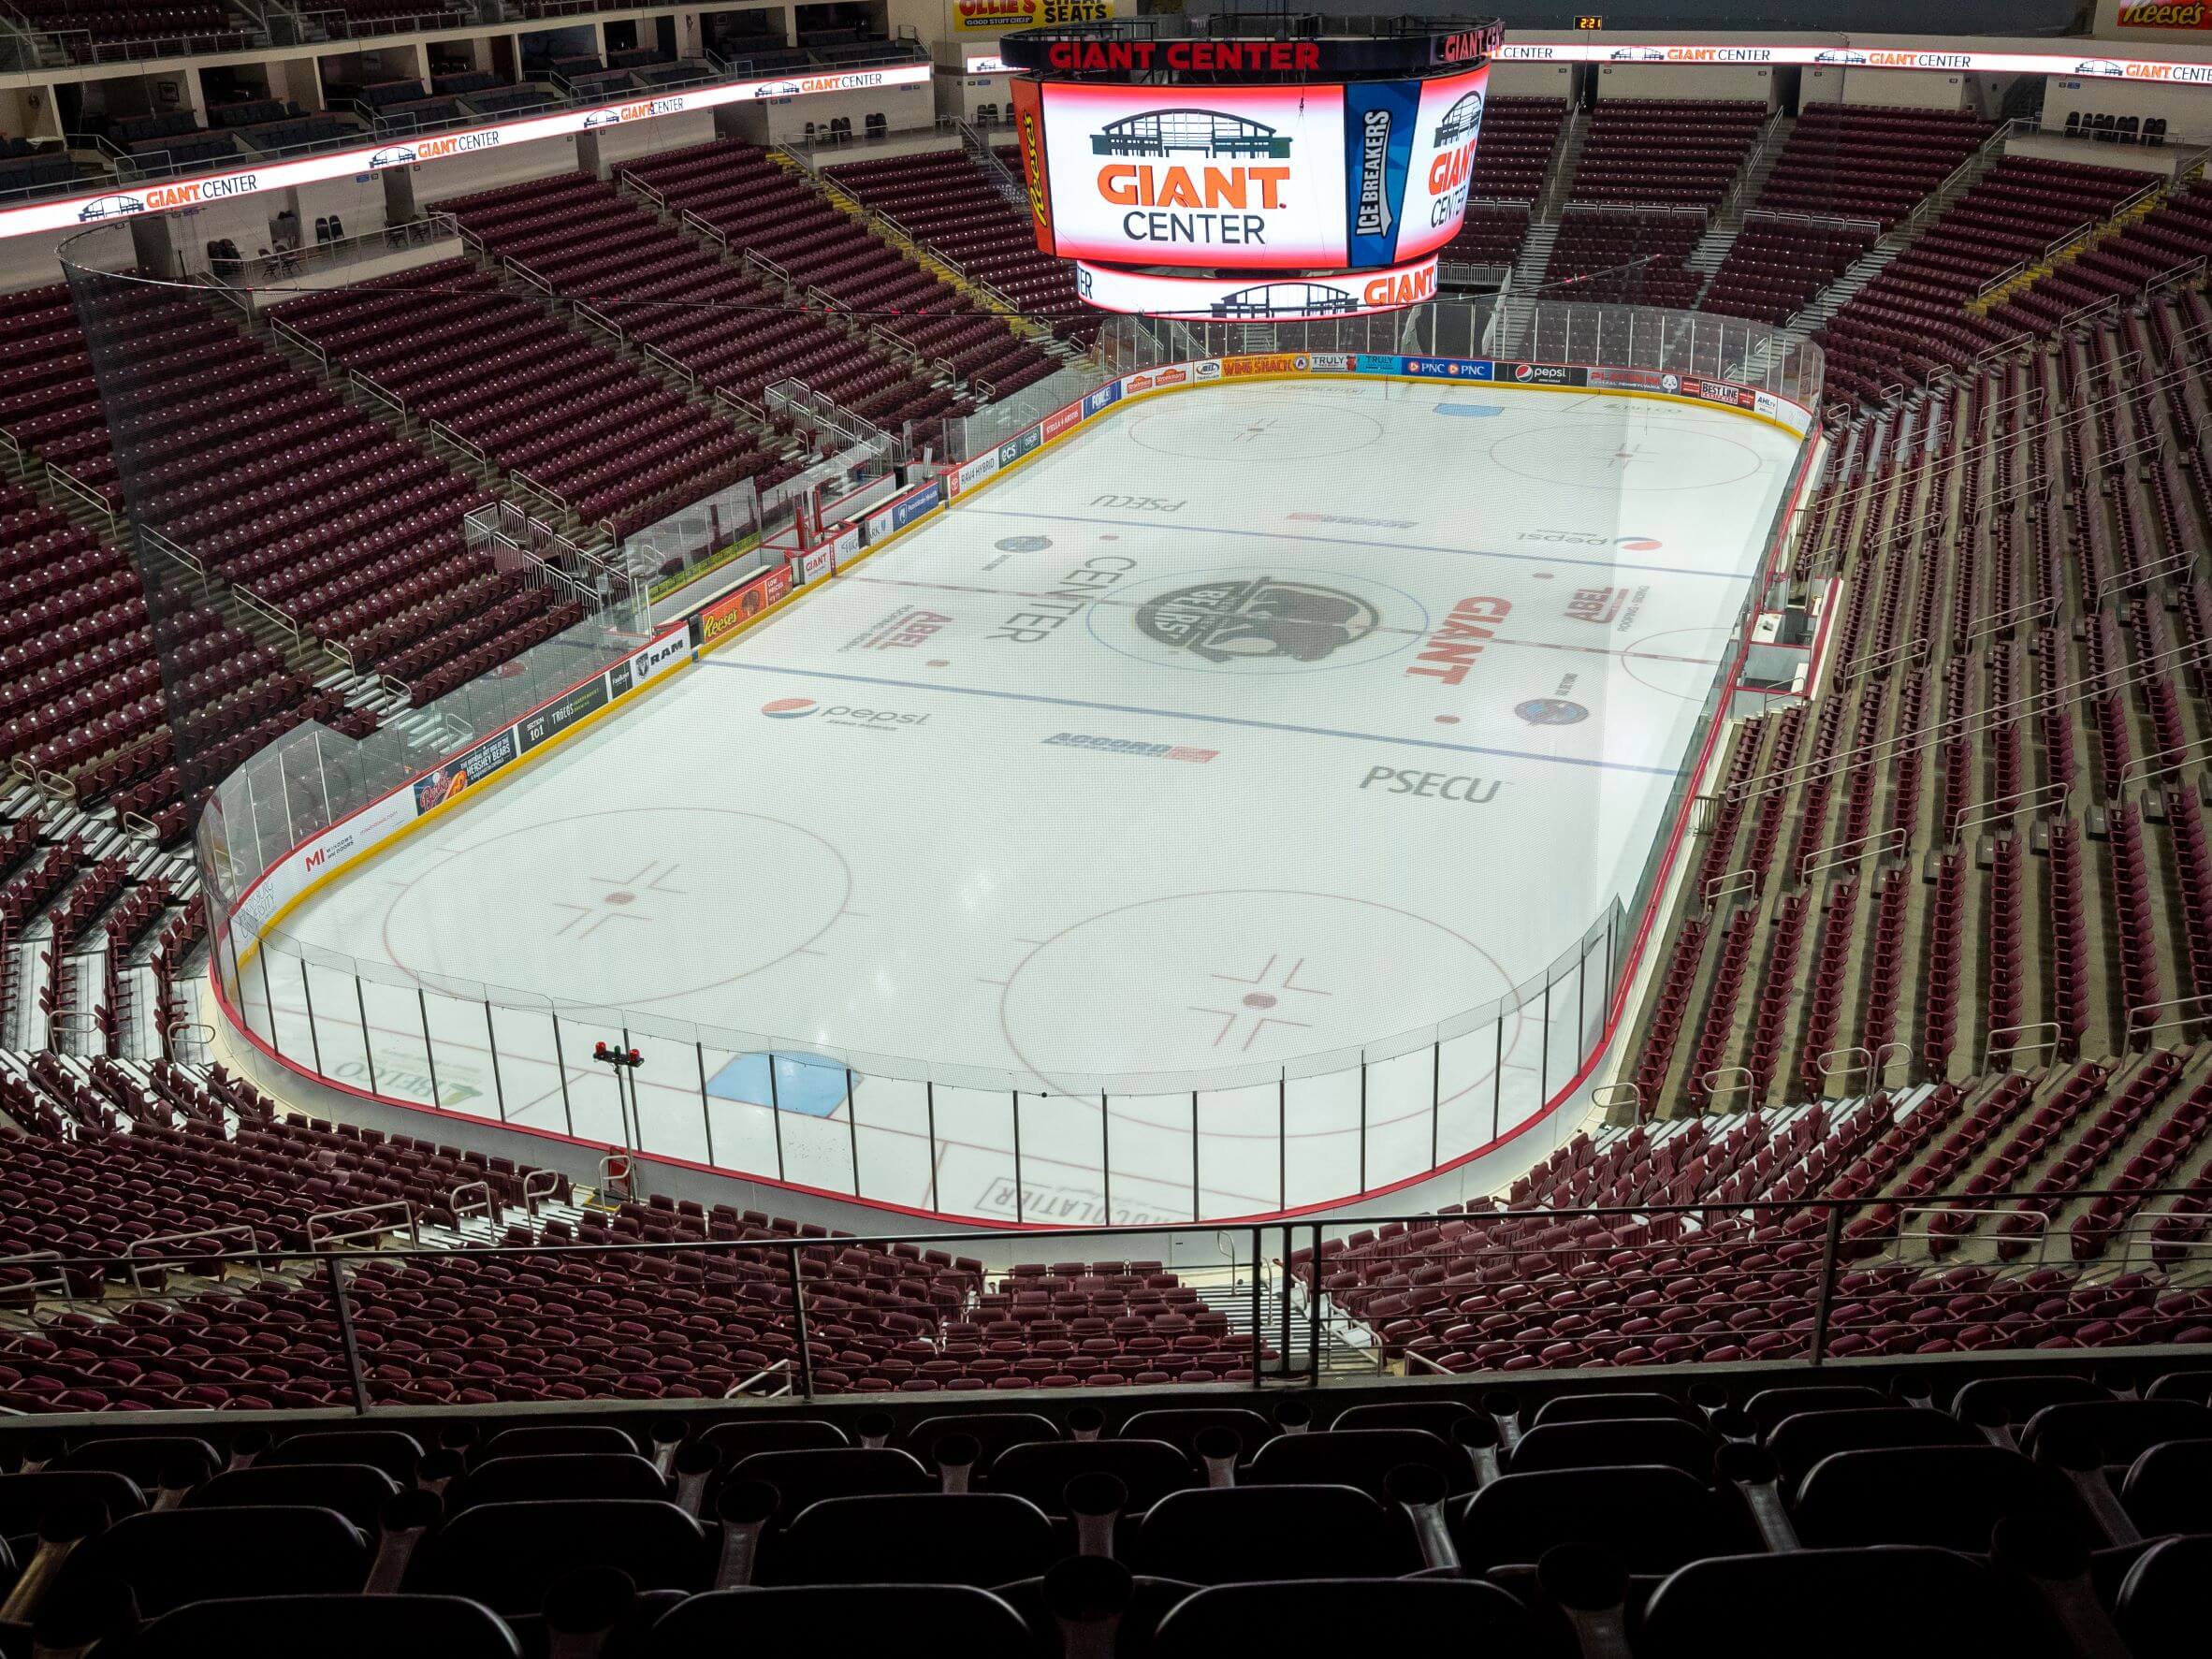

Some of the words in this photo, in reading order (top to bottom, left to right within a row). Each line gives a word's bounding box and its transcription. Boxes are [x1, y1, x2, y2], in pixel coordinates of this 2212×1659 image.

[1044, 4, 1107, 23] SEATS
[2123, 1, 2205, 24] Reese's
[1579, 18, 1601, 29] 2:21
[1049, 42, 1156, 70] GIANT
[1167, 42, 1320, 71] CENTER
[1444, 30, 1484, 62] GIANT
[1504, 47, 1552, 59] CENTER
[1667, 49, 1716, 61] GIANT
[1718, 49, 1770, 61] CENTER
[1869, 52, 1917, 65] GIANT
[1918, 54, 1972, 68] CENTER
[2126, 64, 2172, 79] GIANT
[802, 77, 841, 92] GIANT
[842, 74, 882, 88] CENTER
[620, 104, 651, 123] GIANT
[651, 98, 684, 117] CENTER
[418, 138, 457, 158] GIANT
[458, 131, 499, 151] CENTER
[1362, 110, 1390, 200] BREAKERS
[1023, 109, 1047, 227] Reese's
[1429, 138, 1477, 196] GIANT
[146, 183, 200, 209] GIANT
[202, 174, 257, 198] CENTER
[1123, 211, 1265, 244] CENTER
[1356, 201, 1381, 235] ICE
[1363, 267, 1434, 306] GIANT
[1312, 356, 1345, 364] TRULY
[1366, 356, 1394, 364] TRULY
[1421, 362, 1446, 373] PNC
[1462, 366, 1485, 375] PNC
[1534, 367, 1566, 378] pepsi
[1702, 383, 1721, 394] BEST
[1723, 386, 1738, 399] LINE
[975, 458, 995, 475] HYBRID
[1090, 495, 1187, 512] PSECU
[1516, 531, 1608, 546] pepsi
[806, 552, 827, 571] GIANT
[984, 556, 1137, 643] CENTER
[704, 607, 738, 638] Reese's
[1404, 595, 1513, 686] GIANT
[650, 639, 684, 667] RAM
[821, 706, 931, 726] pepsi
[530, 724, 544, 741] 101
[467, 755, 492, 776] HERSHEY
[492, 743, 510, 761] BEARS
[1359, 765, 1501, 804] PSECU
[327, 835, 353, 853] WINDOWS
[337, 840, 354, 854] DOORS
[305, 848, 325, 872] MI
[335, 1061, 444, 1098] BELCO
